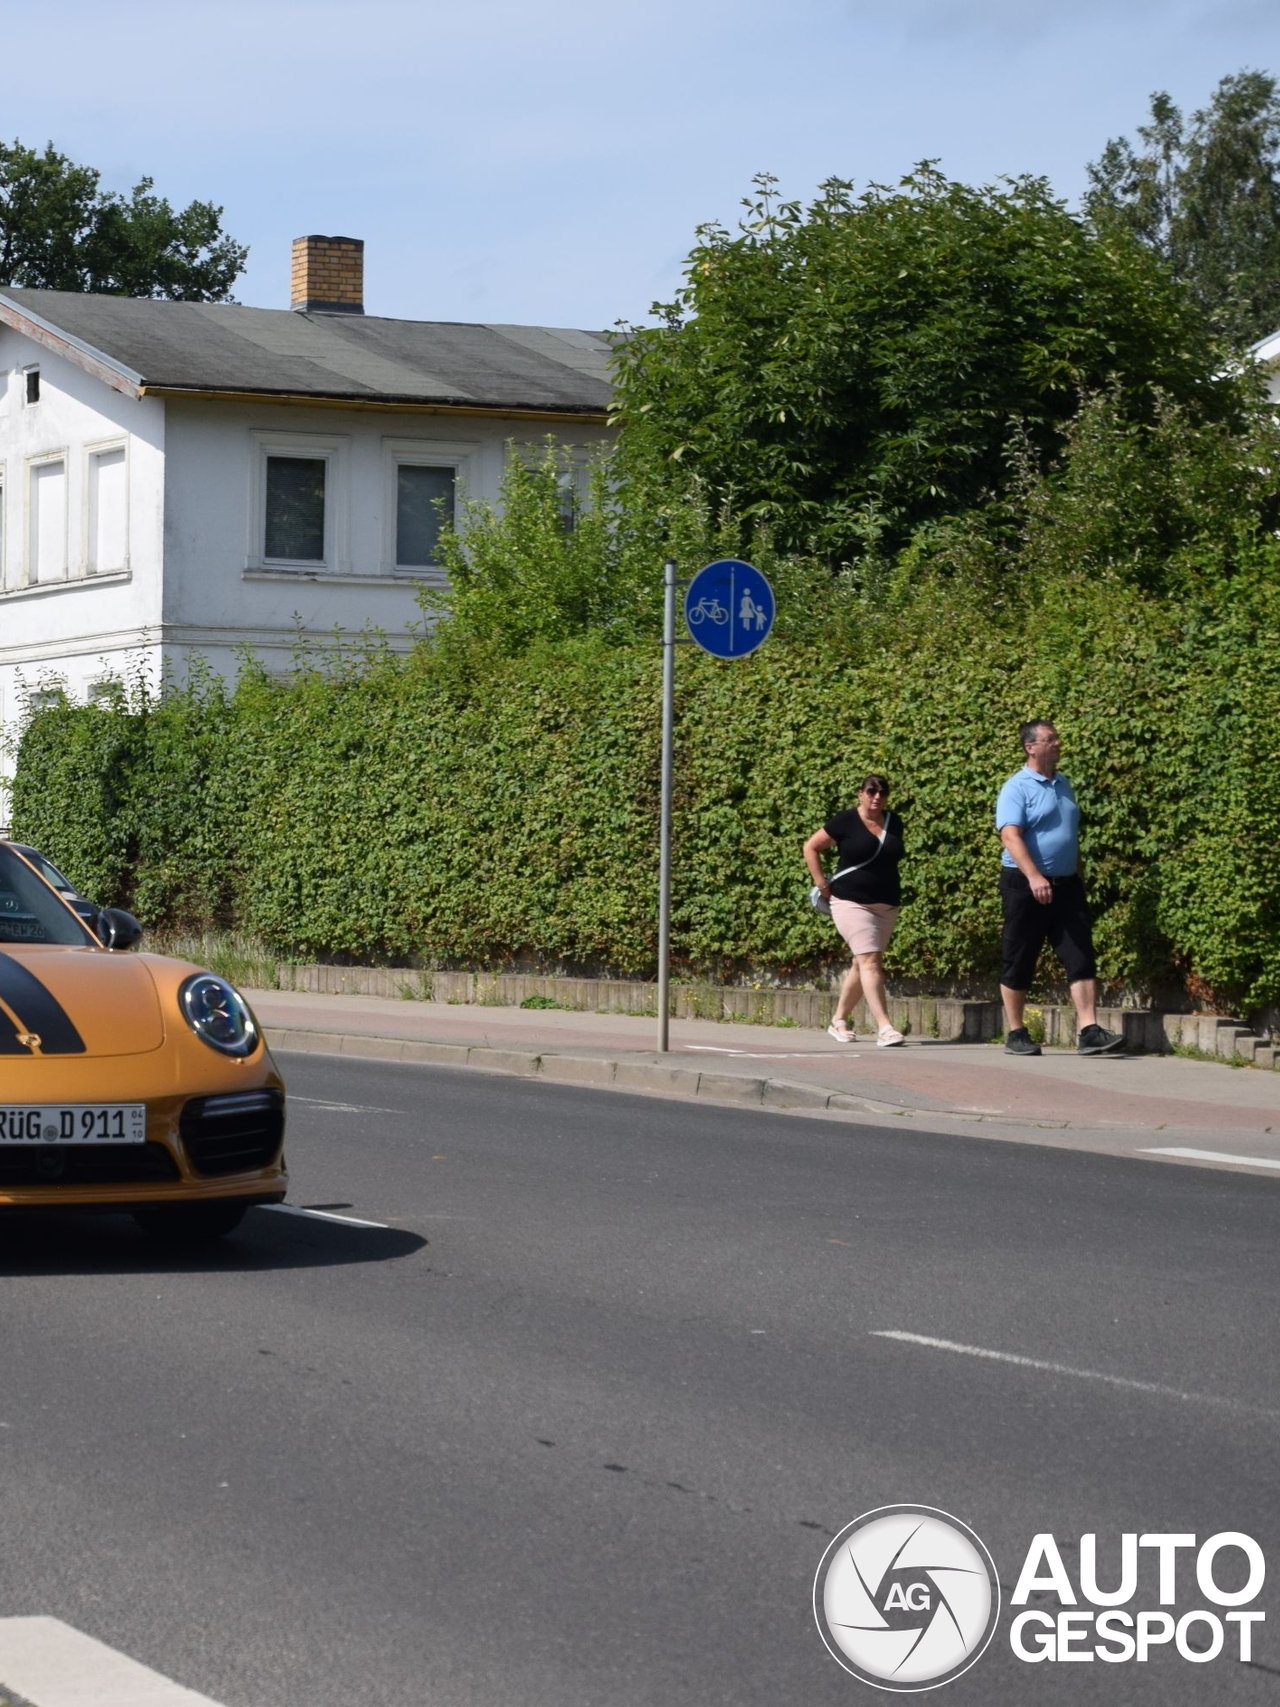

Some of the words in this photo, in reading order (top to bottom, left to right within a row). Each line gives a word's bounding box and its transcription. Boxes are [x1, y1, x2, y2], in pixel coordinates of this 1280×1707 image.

[131, 1110, 143, 1119] 04
[59, 1110, 75, 1140] D
[81, 1110, 126, 1140] 911
